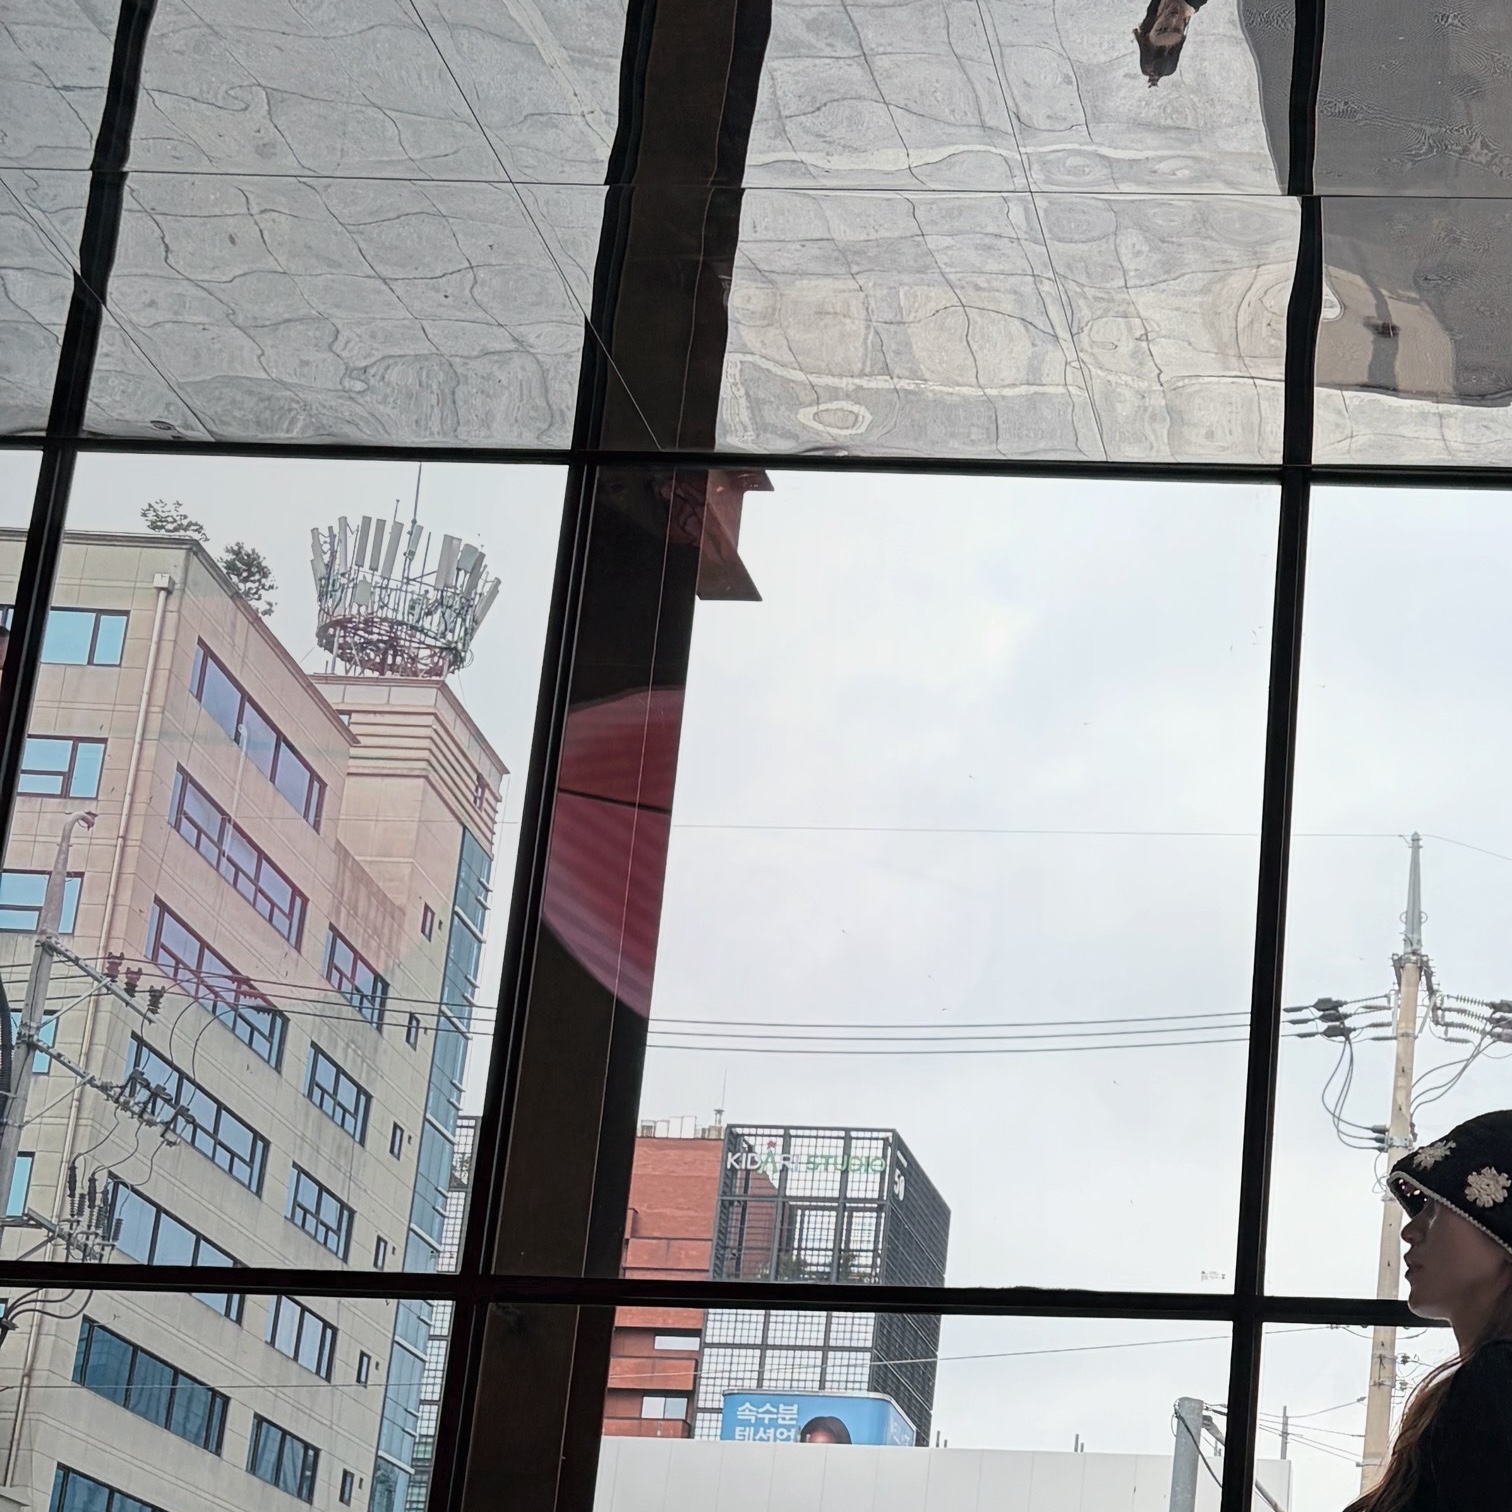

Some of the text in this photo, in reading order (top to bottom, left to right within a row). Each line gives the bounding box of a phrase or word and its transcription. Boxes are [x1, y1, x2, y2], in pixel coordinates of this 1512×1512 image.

[727, 1150, 886, 1174] KIDARI STUDIO
[736, 1402, 799, 1425] 속수분
